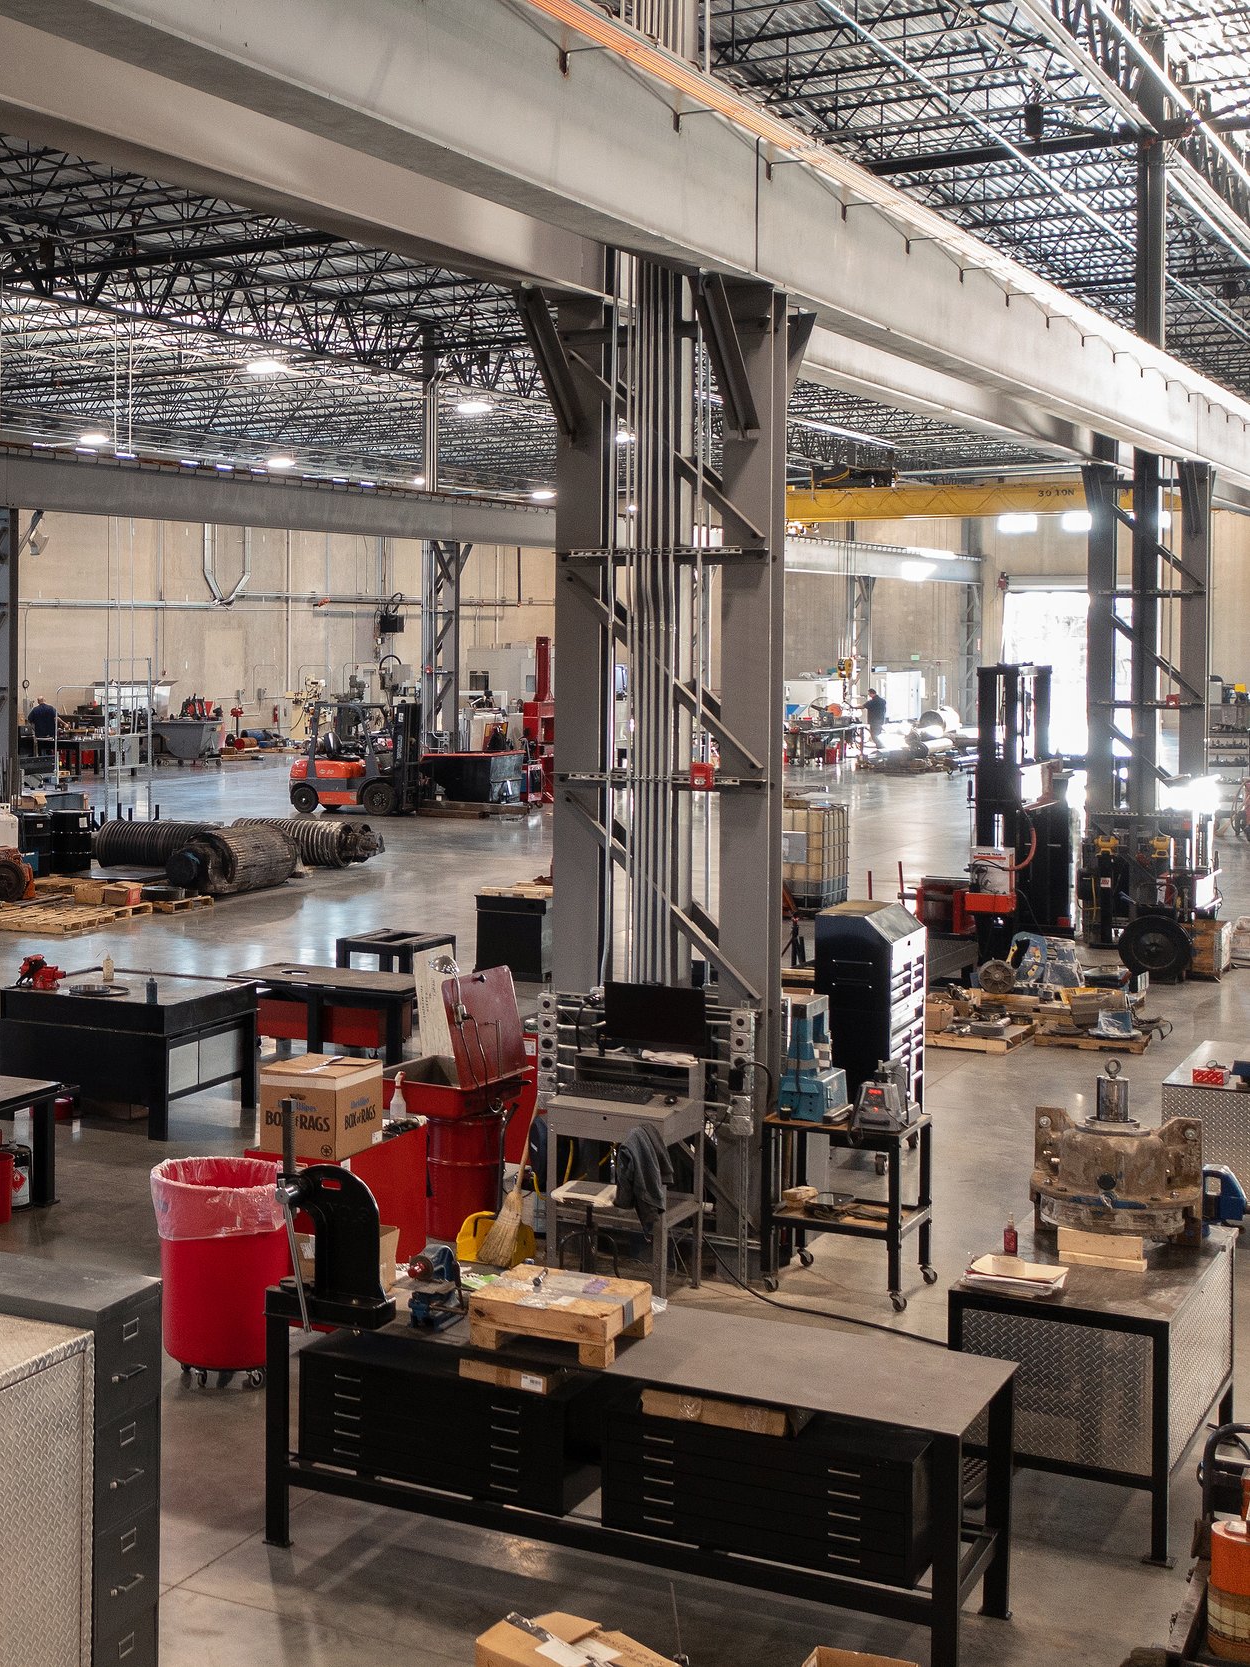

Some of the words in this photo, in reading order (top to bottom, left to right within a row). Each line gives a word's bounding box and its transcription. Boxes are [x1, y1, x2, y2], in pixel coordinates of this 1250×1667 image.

[265, 1110, 284, 1127] BO
[299, 1113, 330, 1132] RAGS
[344, 1110, 357, 1130] BOX
[361, 1104, 376, 1124] RAGS
